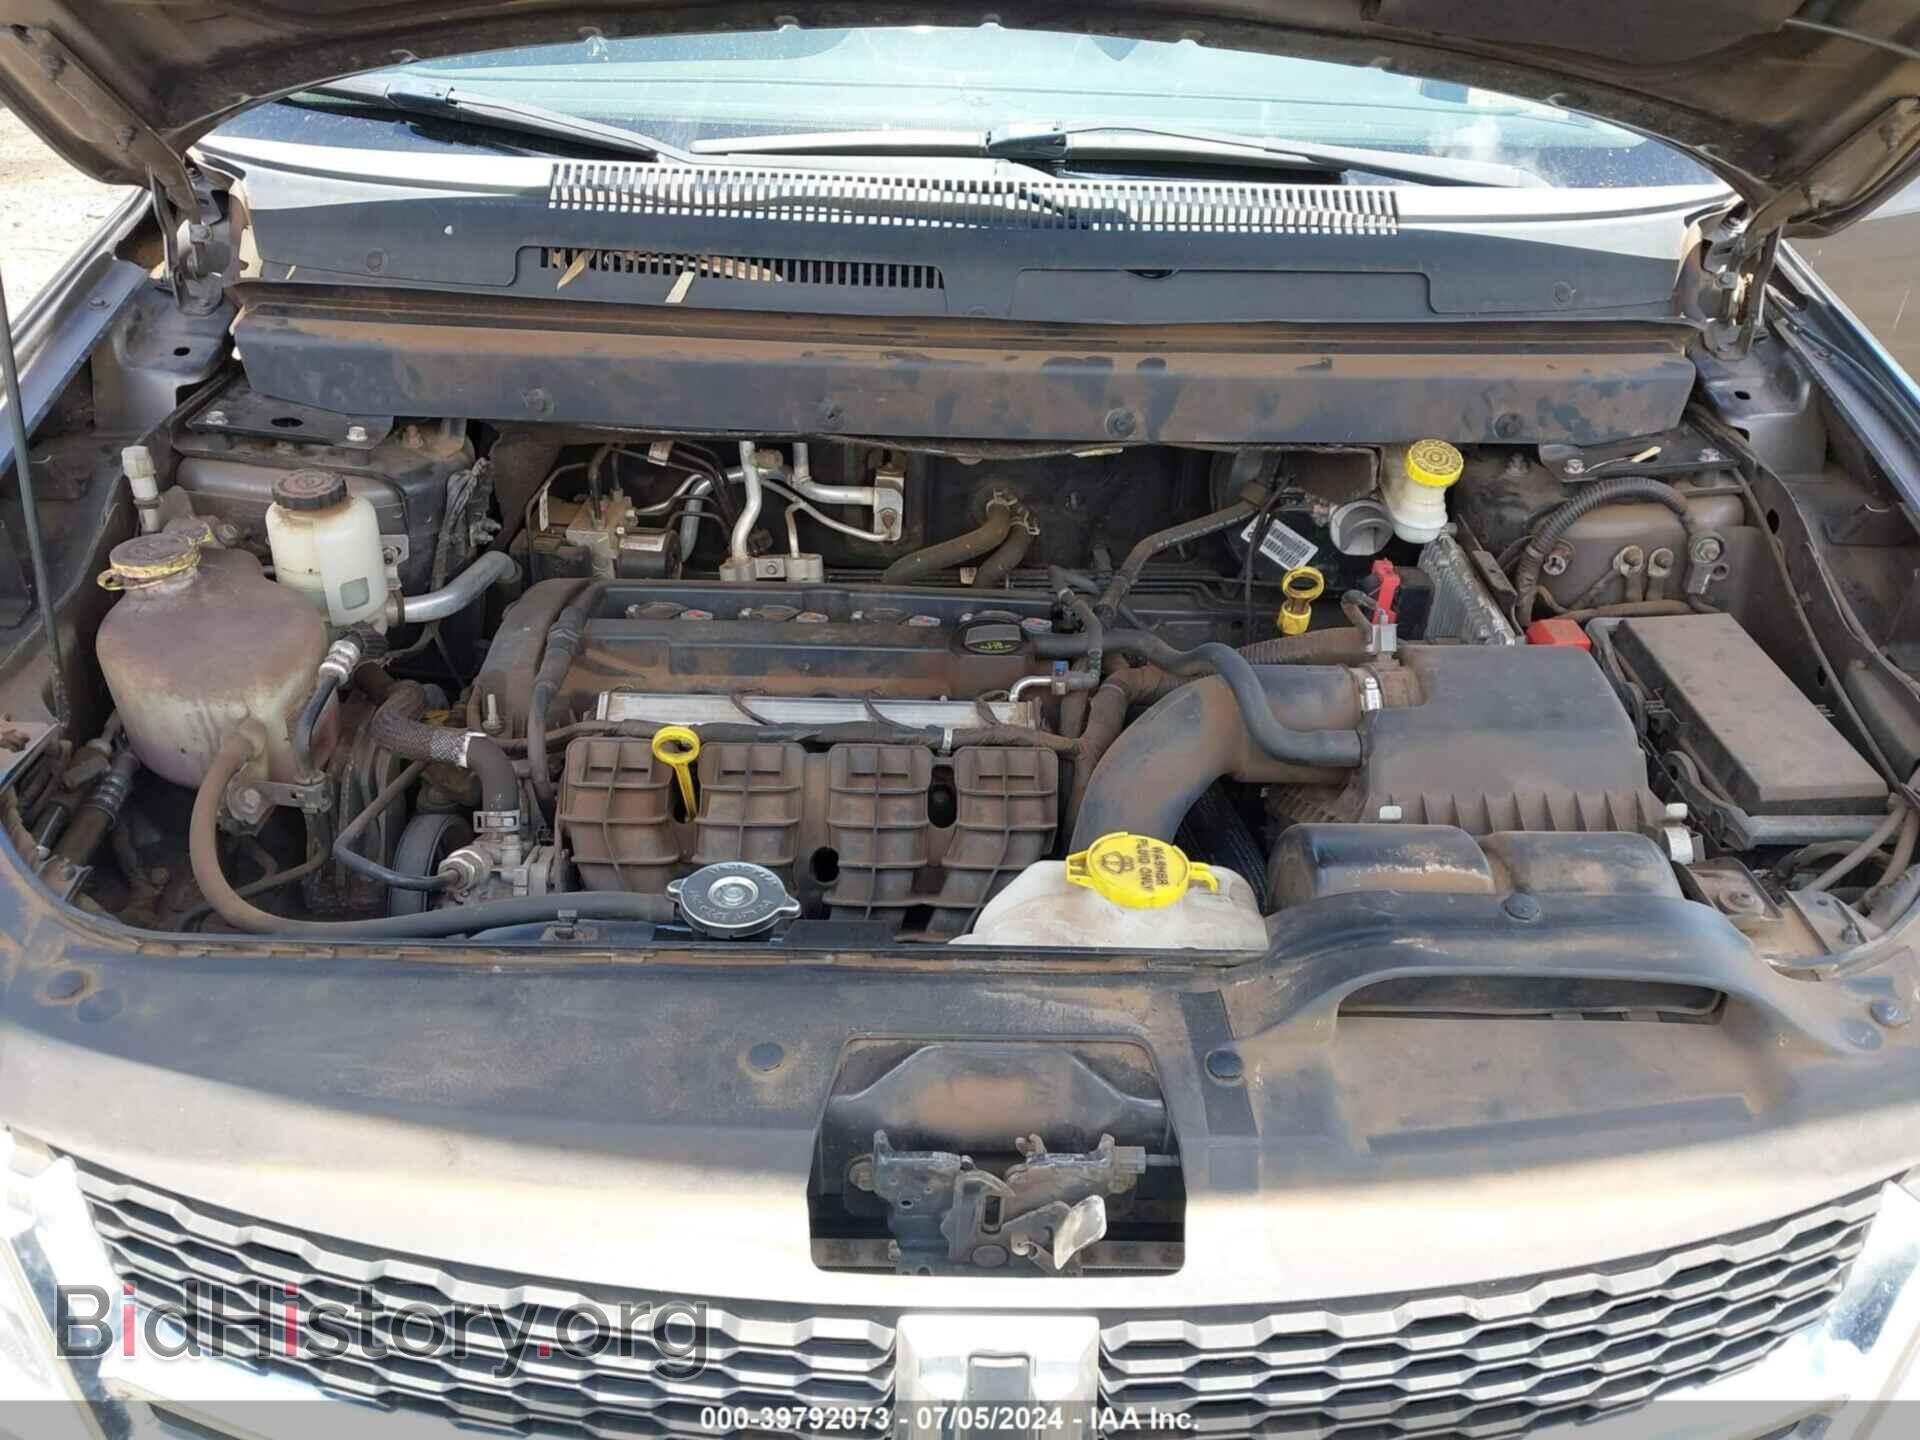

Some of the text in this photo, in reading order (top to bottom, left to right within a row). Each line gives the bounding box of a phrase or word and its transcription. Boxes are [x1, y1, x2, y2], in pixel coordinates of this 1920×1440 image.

[1136, 838, 1155, 892] FLUID ONLY
[1152, 846, 1169, 886] WASHER
